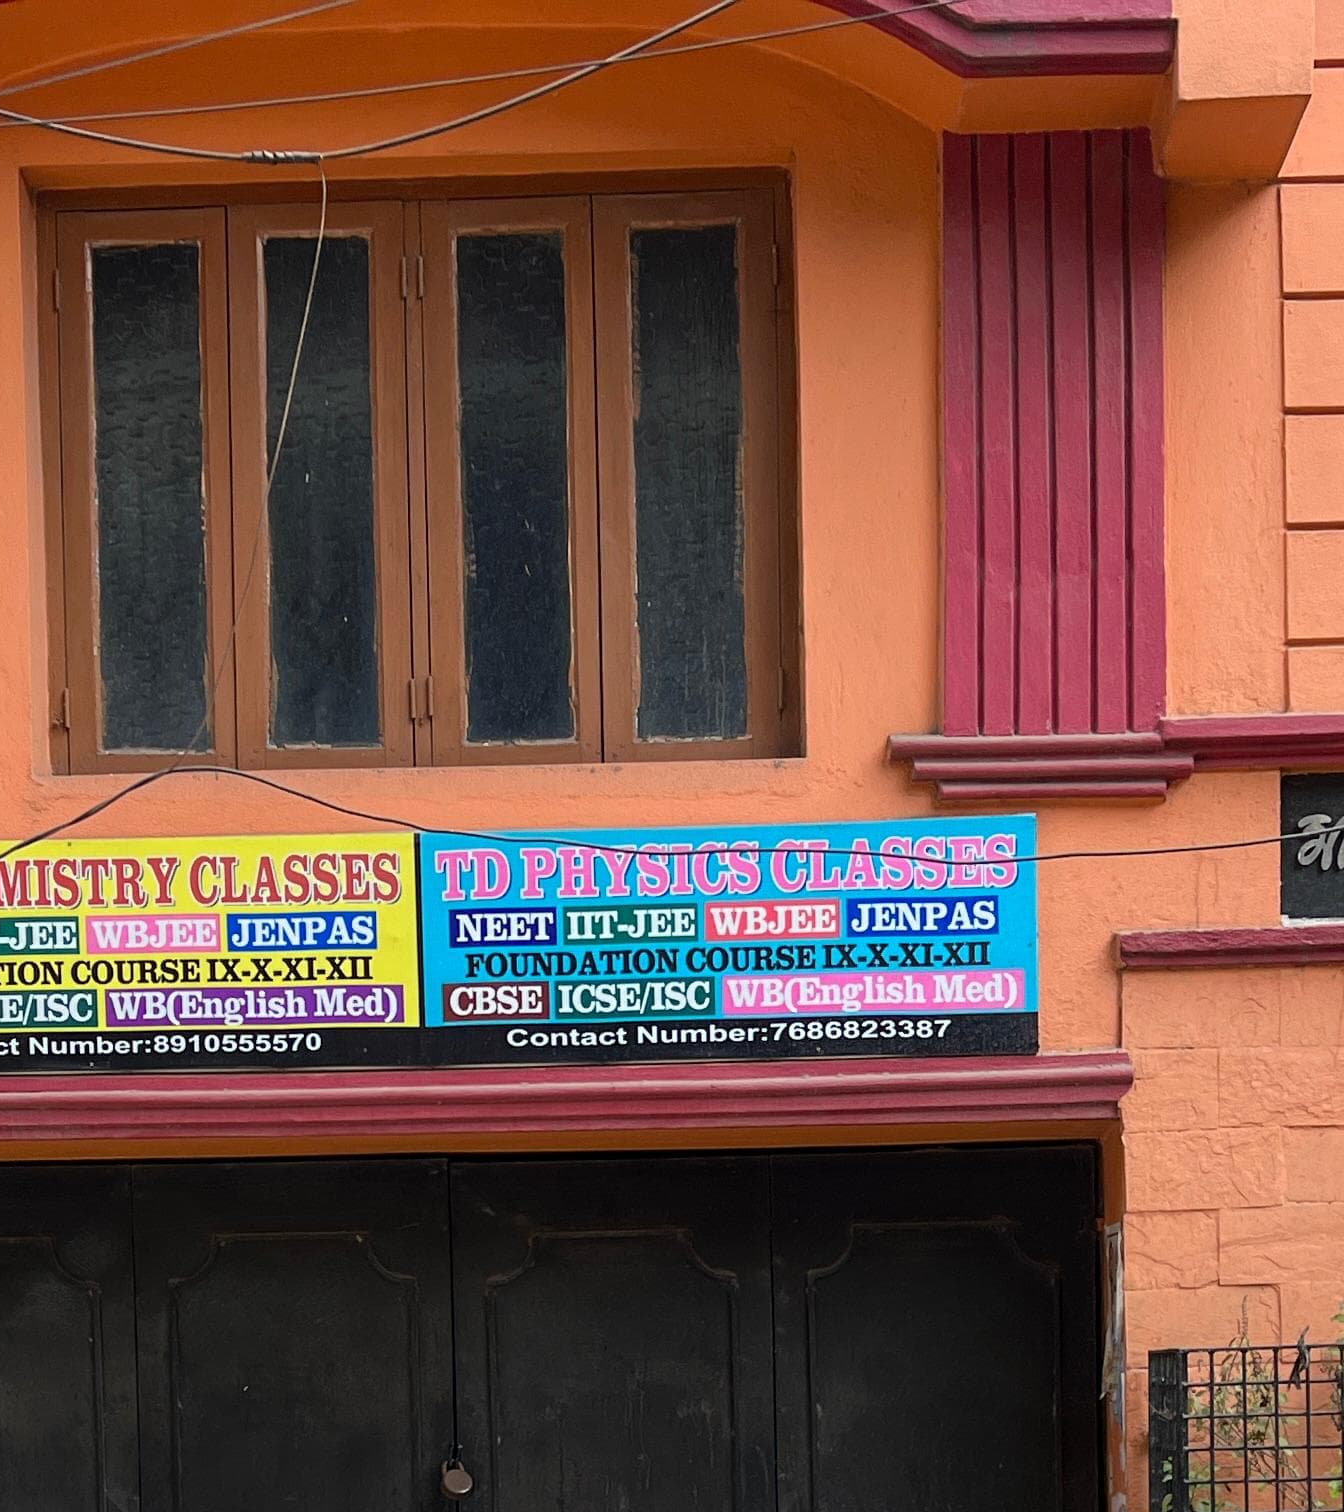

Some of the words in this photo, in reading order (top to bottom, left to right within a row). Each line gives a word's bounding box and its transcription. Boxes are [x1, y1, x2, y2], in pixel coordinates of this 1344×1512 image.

[189, 852, 402, 904] CLASSES
[435, 849, 513, 900] TD
[519, 840, 761, 899] PHYSICS
[771, 834, 1018, 895] CLASSES
[92, 918, 218, 949] WBJEE
[231, 914, 375, 948] JENPAS
[455, 911, 554, 942] NEET
[567, 908, 697, 941] IIT-JEE
[709, 904, 838, 936] WBJEE
[851, 899, 997, 933] JENPAS
[71, 958, 201, 986] COURSE
[206, 956, 373, 984] IX-X-XI-XII
[465, 946, 680, 978] FOUNDATION
[686, 944, 817, 973] COURSE
[822, 942, 991, 970] IX-X-XI-XII
[110, 990, 311, 1029] WB(English
[315, 987, 399, 1022] Med)
[448, 985, 544, 1016] CBSE
[558, 980, 711, 1014] ICSE/ISC
[726, 976, 929, 1013] WB(English
[933, 973, 1019, 1009] Med)
[506, 1025, 628, 1048] Contact
